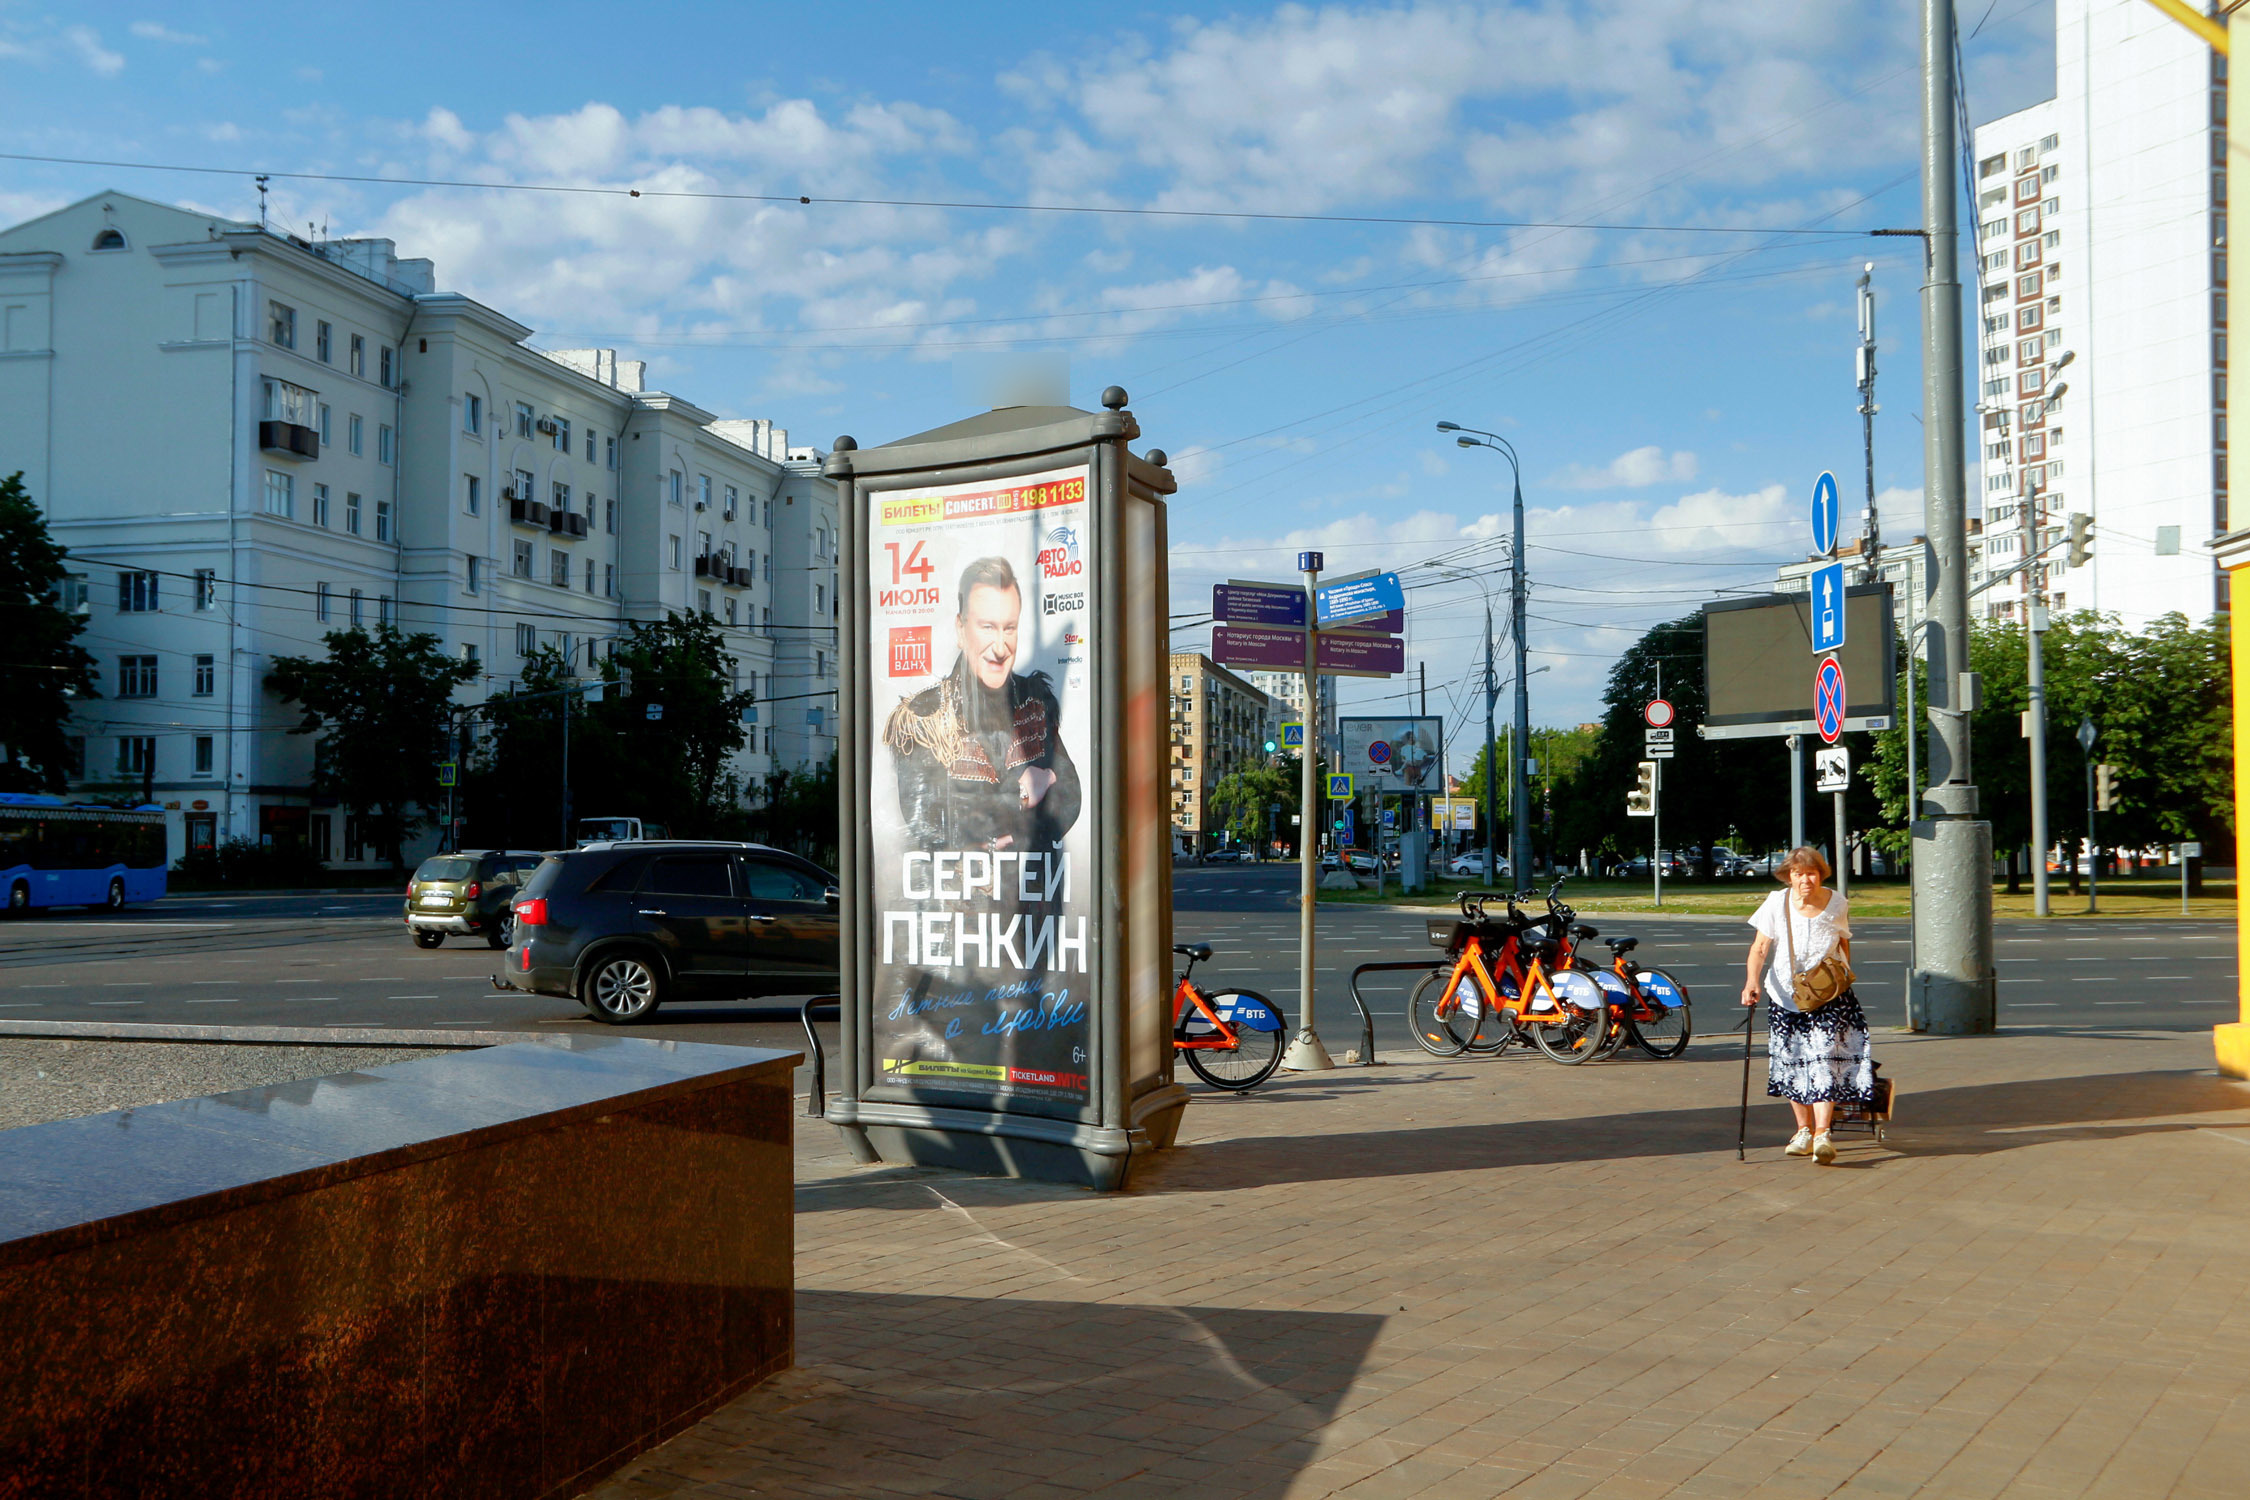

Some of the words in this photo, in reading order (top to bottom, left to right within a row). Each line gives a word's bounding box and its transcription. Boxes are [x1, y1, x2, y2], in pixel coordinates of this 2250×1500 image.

[884, 503, 940, 519] БИЛЕТЫ
[1021, 488, 1047, 507] 198
[1050, 481, 1083, 502] 1133
[884, 540, 934, 584] 14
[1035, 547, 1066, 566] АВТО
[1044, 560, 1082, 579] РАДИО
[880, 587, 939, 607] ИЮЛЯ
[1058, 600, 1084, 612] GOLD
[1064, 633, 1079, 643] Star
[1227, 632, 1252, 641] Нотариус
[1227, 639, 1242, 647] Notary
[1330, 639, 1354, 647] Нотариус
[894, 660, 926, 671] ВДНХ
[902, 840, 1071, 903] СЕРГЕЙ
[883, 911, 1087, 973] ПЕНКИН
[888, 988, 975, 1020] Летние
[985, 978, 1043, 1001] песни
[1573, 987, 1590, 997] ВТБ
[1656, 987, 1671, 996] ВТБ
[982, 988, 1085, 1038] любви
[1246, 1009, 1266, 1019] ВТБ
[1073, 1046, 1086, 1064] 6+
[919, 1064, 959, 1073] БИЛЕТЫ
[1011, 1070, 1055, 1083] TICKETLAND
[1056, 1071, 1088, 1091] МТС
